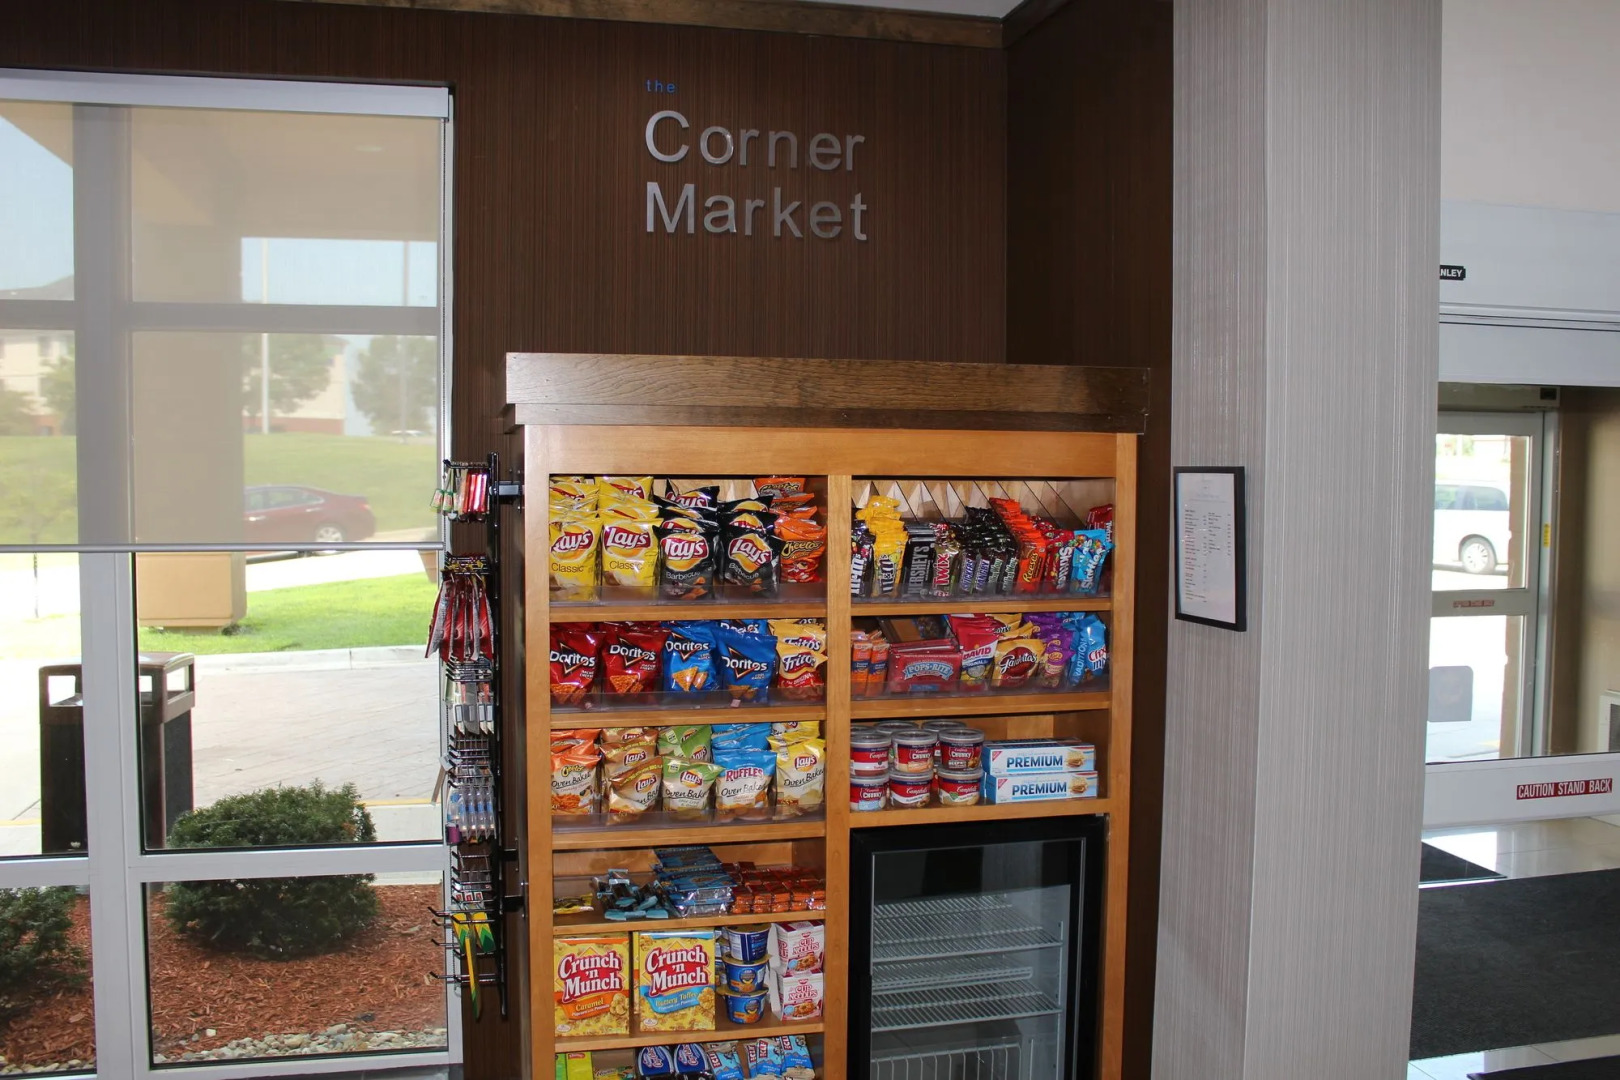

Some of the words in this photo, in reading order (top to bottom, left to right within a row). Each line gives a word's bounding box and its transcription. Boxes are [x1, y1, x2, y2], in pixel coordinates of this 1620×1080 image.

[646, 80, 676, 93] the
[645, 110, 866, 171] Corner
[646, 181, 867, 241] Market
[1440, 268, 1463, 278] NLEY
[606, 526, 650, 549] Lay's
[664, 538, 705, 560] Lay's
[731, 540, 770, 564] Lay's
[551, 563, 584, 573] Classic
[609, 560, 643, 570] Classic
[908, 545, 930, 594] HERSHEY'S
[1022, 552, 1039, 583] Reese's
[610, 644, 657, 661] Doritos
[665, 640, 710, 652] Doritos
[962, 646, 992, 660] DAVID
[549, 650, 596, 667] Doritos
[722, 656, 768, 671] Doritos
[795, 754, 817, 768] Lay's
[1006, 755, 1063, 768] PREMIUM
[726, 767, 764, 782] RUFFLES
[720, 788, 743, 798] Oven
[1012, 782, 1067, 796] PREMIUM
[1519, 783, 1554, 799] CAUTION
[1557, 781, 1586, 795] STAND
[1589, 778, 1611, 793] BACK
[559, 951, 620, 978] Crunch
[646, 945, 706, 972] Crunch
[585, 968, 598, 978] 'n
[672, 963, 685, 972] 'n
[564, 975, 621, 1000] Munch
[651, 967, 707, 994] Munch
[575, 999, 604, 1012] Caramel
